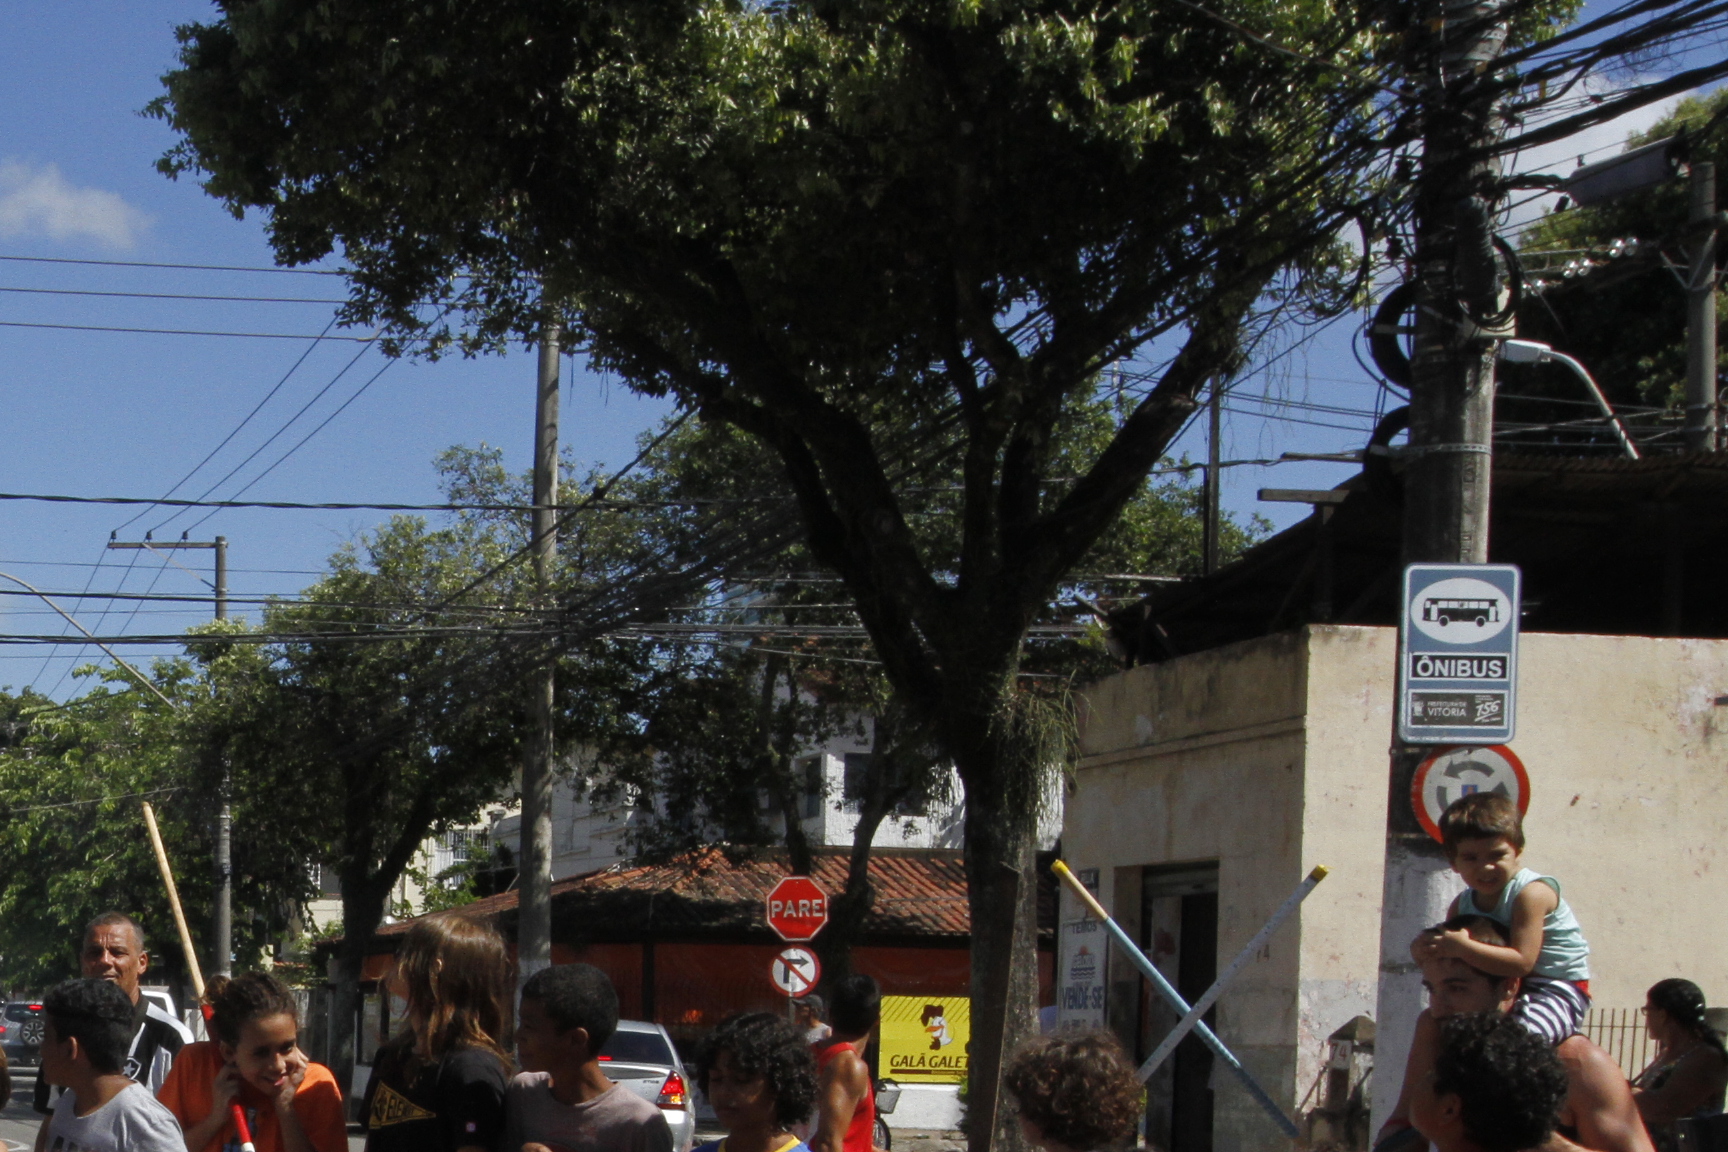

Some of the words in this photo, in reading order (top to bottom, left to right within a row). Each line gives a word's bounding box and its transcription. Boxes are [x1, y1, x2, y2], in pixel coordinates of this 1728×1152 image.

[1417, 656, 1502, 678] ÔNIBUS
[1475, 700, 1501, 717] 156
[771, 898, 824, 918] PARE
[1062, 986, 1104, 1010] VENDE-SE
[889, 1052, 926, 1068] GALÃ
